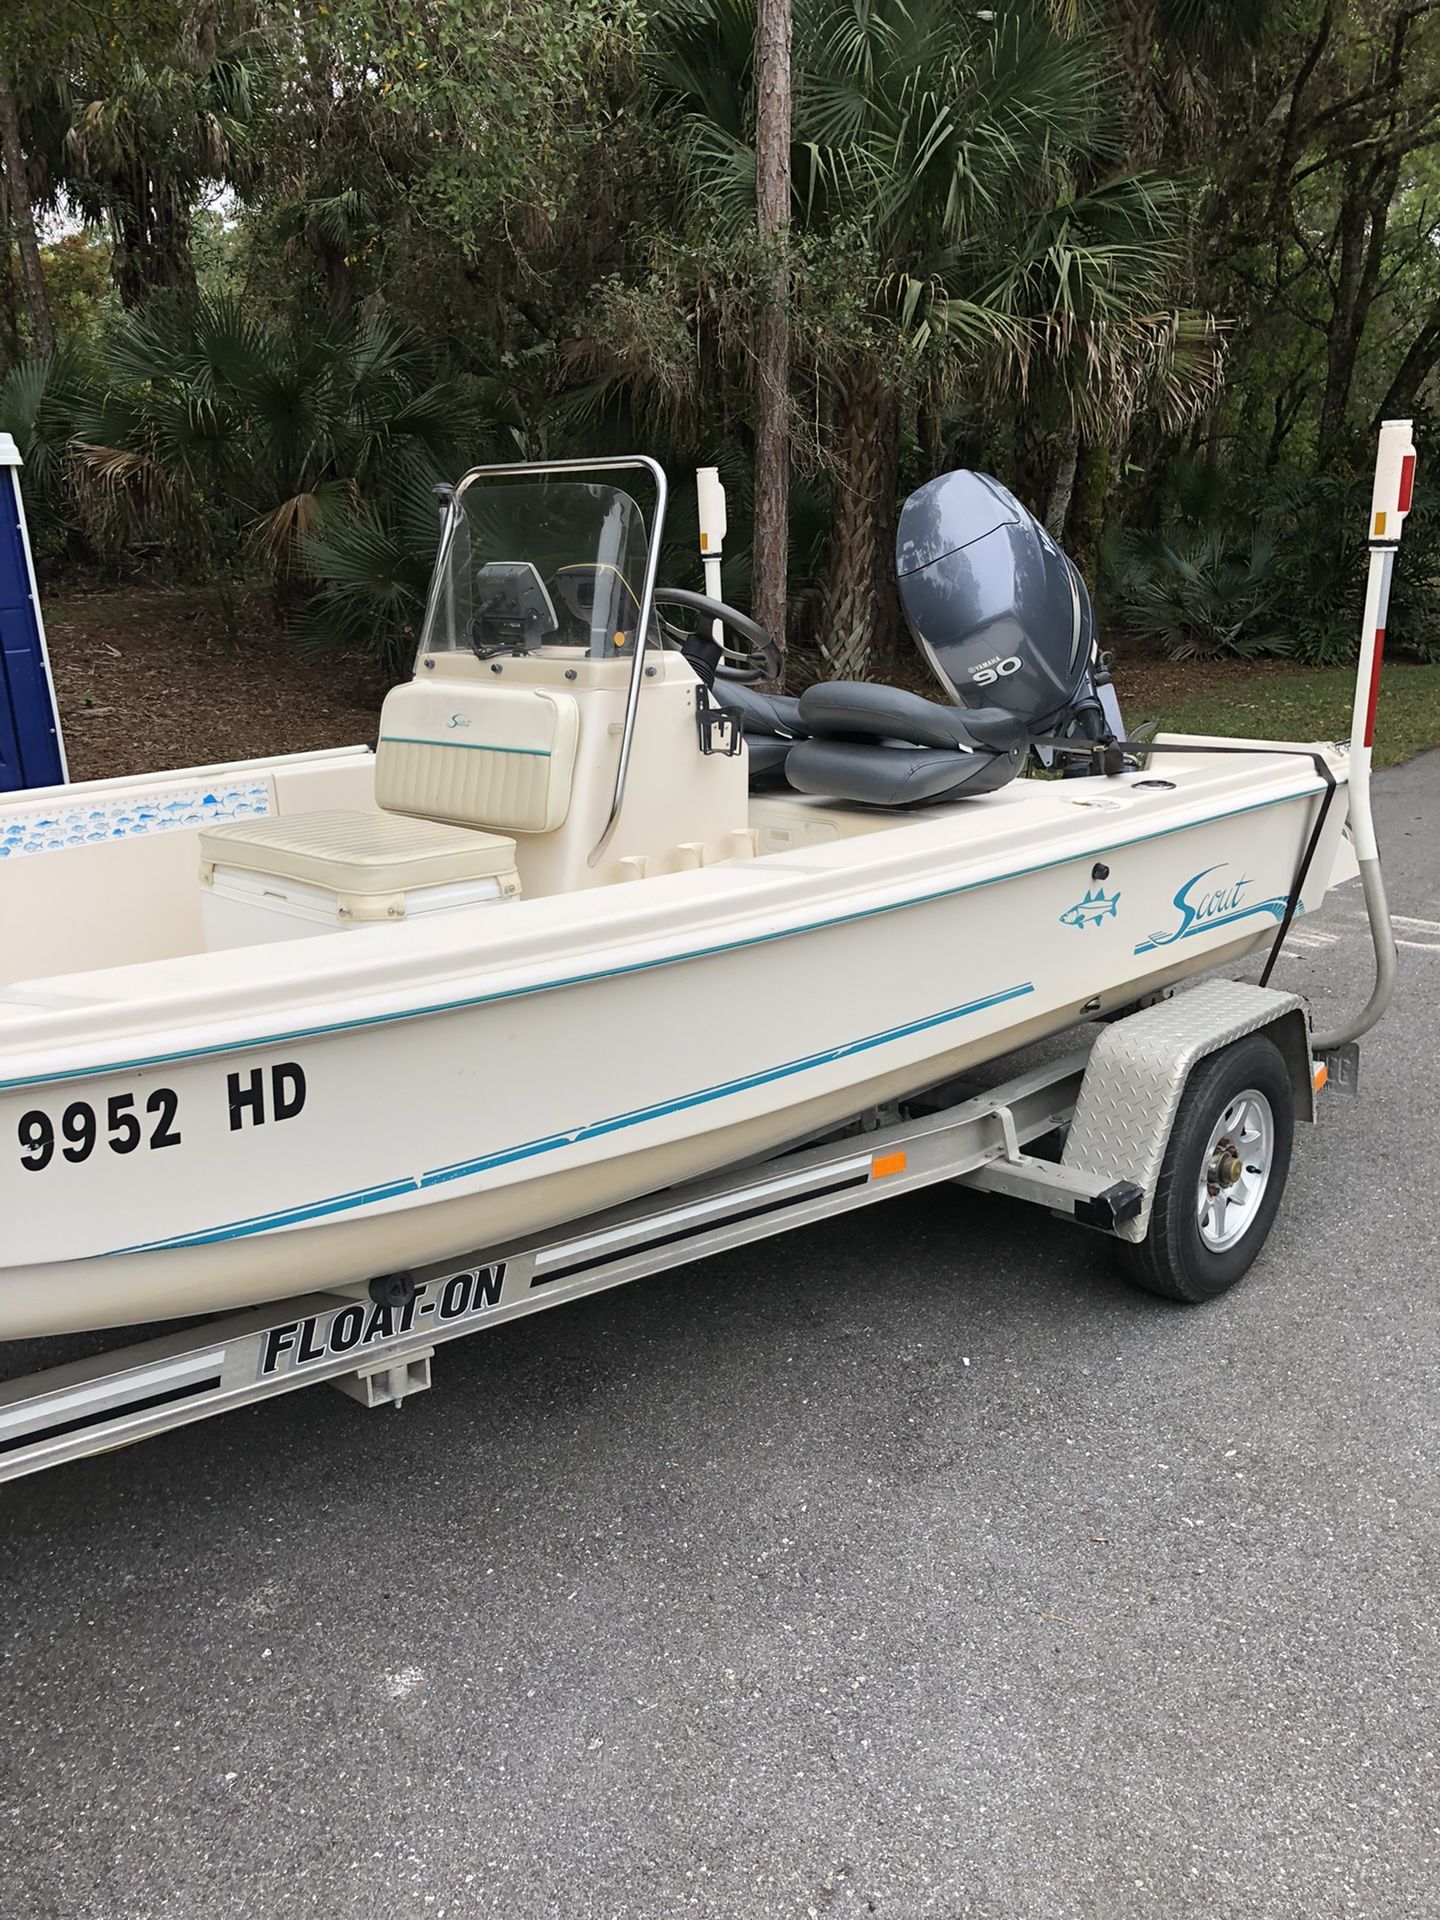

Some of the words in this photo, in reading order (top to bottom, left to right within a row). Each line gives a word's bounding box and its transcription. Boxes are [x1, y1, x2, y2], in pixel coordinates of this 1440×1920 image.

[973, 656, 1022, 687] 90
[975, 656, 1001, 671] YAMAHA
[1149, 862, 1254, 946] Scout
[17, 1088, 182, 1172] 9952
[226, 1061, 307, 1132] HD
[261, 1263, 507, 1376] FLOAT-ON
